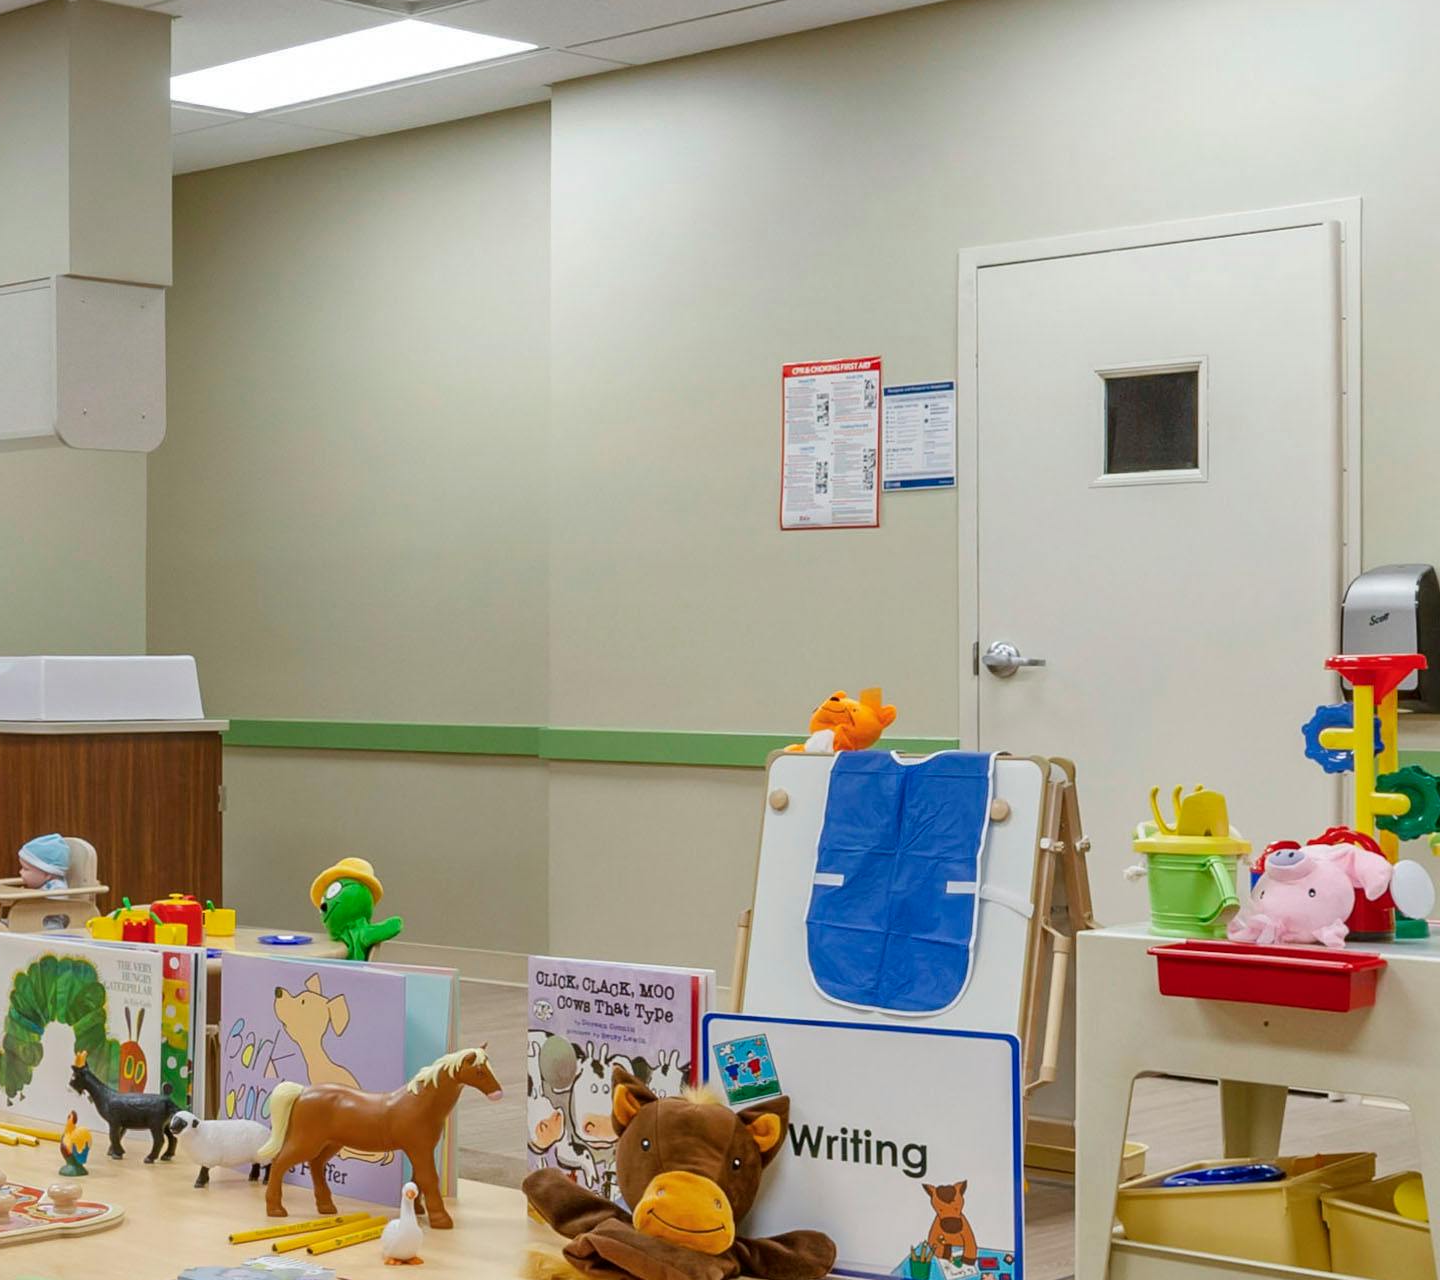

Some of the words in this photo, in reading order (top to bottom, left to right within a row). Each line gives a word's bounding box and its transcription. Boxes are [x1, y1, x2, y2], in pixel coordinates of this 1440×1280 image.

[118, 960, 133, 972] THE
[536, 971, 579, 990] CLICK,
[582, 977, 635, 999] CLACK,
[640, 983, 675, 1001] MOO
[557, 995, 591, 1013] Cows
[594, 999, 630, 1017] That
[635, 1003, 674, 1025] Type
[788, 1123, 928, 1179] Writing
